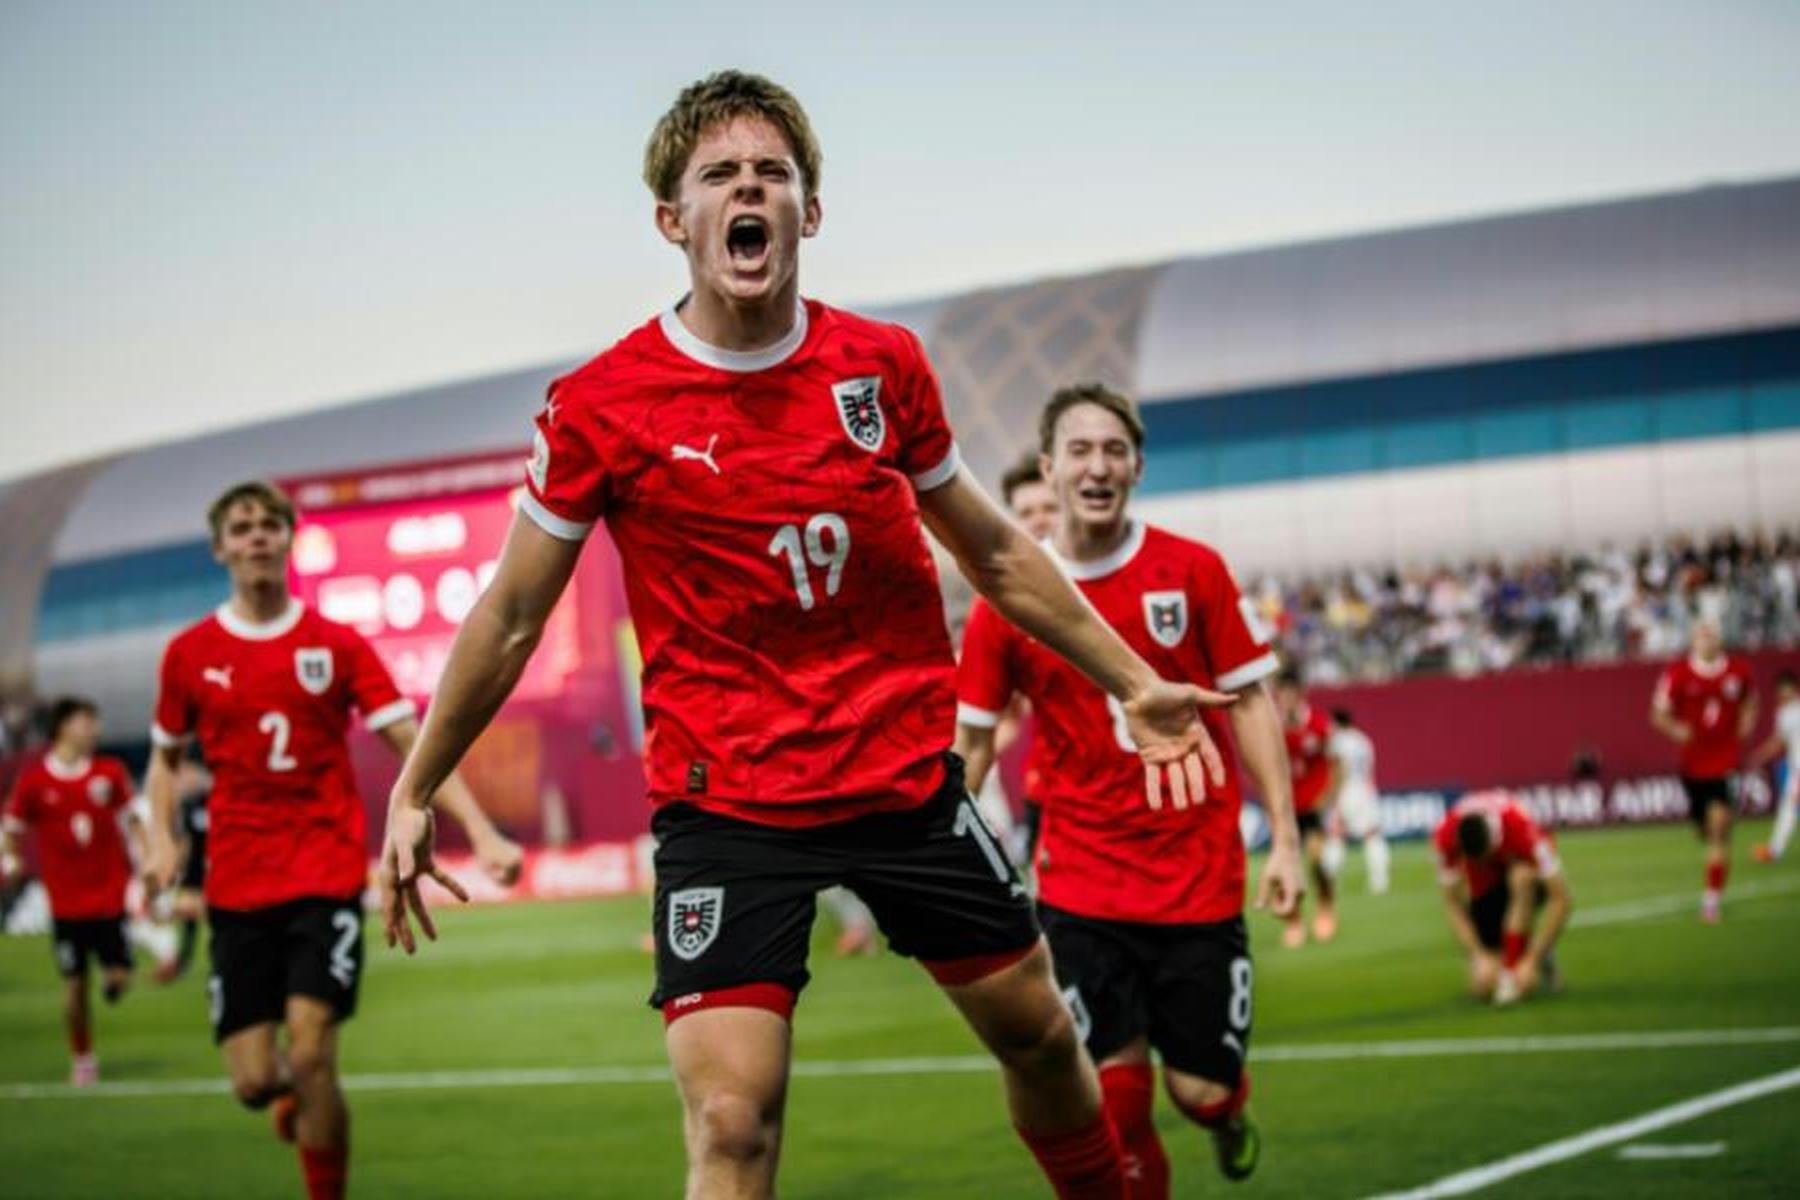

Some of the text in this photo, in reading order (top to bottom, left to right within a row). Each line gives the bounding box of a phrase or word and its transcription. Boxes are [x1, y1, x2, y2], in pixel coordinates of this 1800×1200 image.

[768, 512, 851, 611] 19
[258, 711, 298, 771] 2
[331, 910, 359, 966] 2
[1228, 957, 1252, 1031] 8
